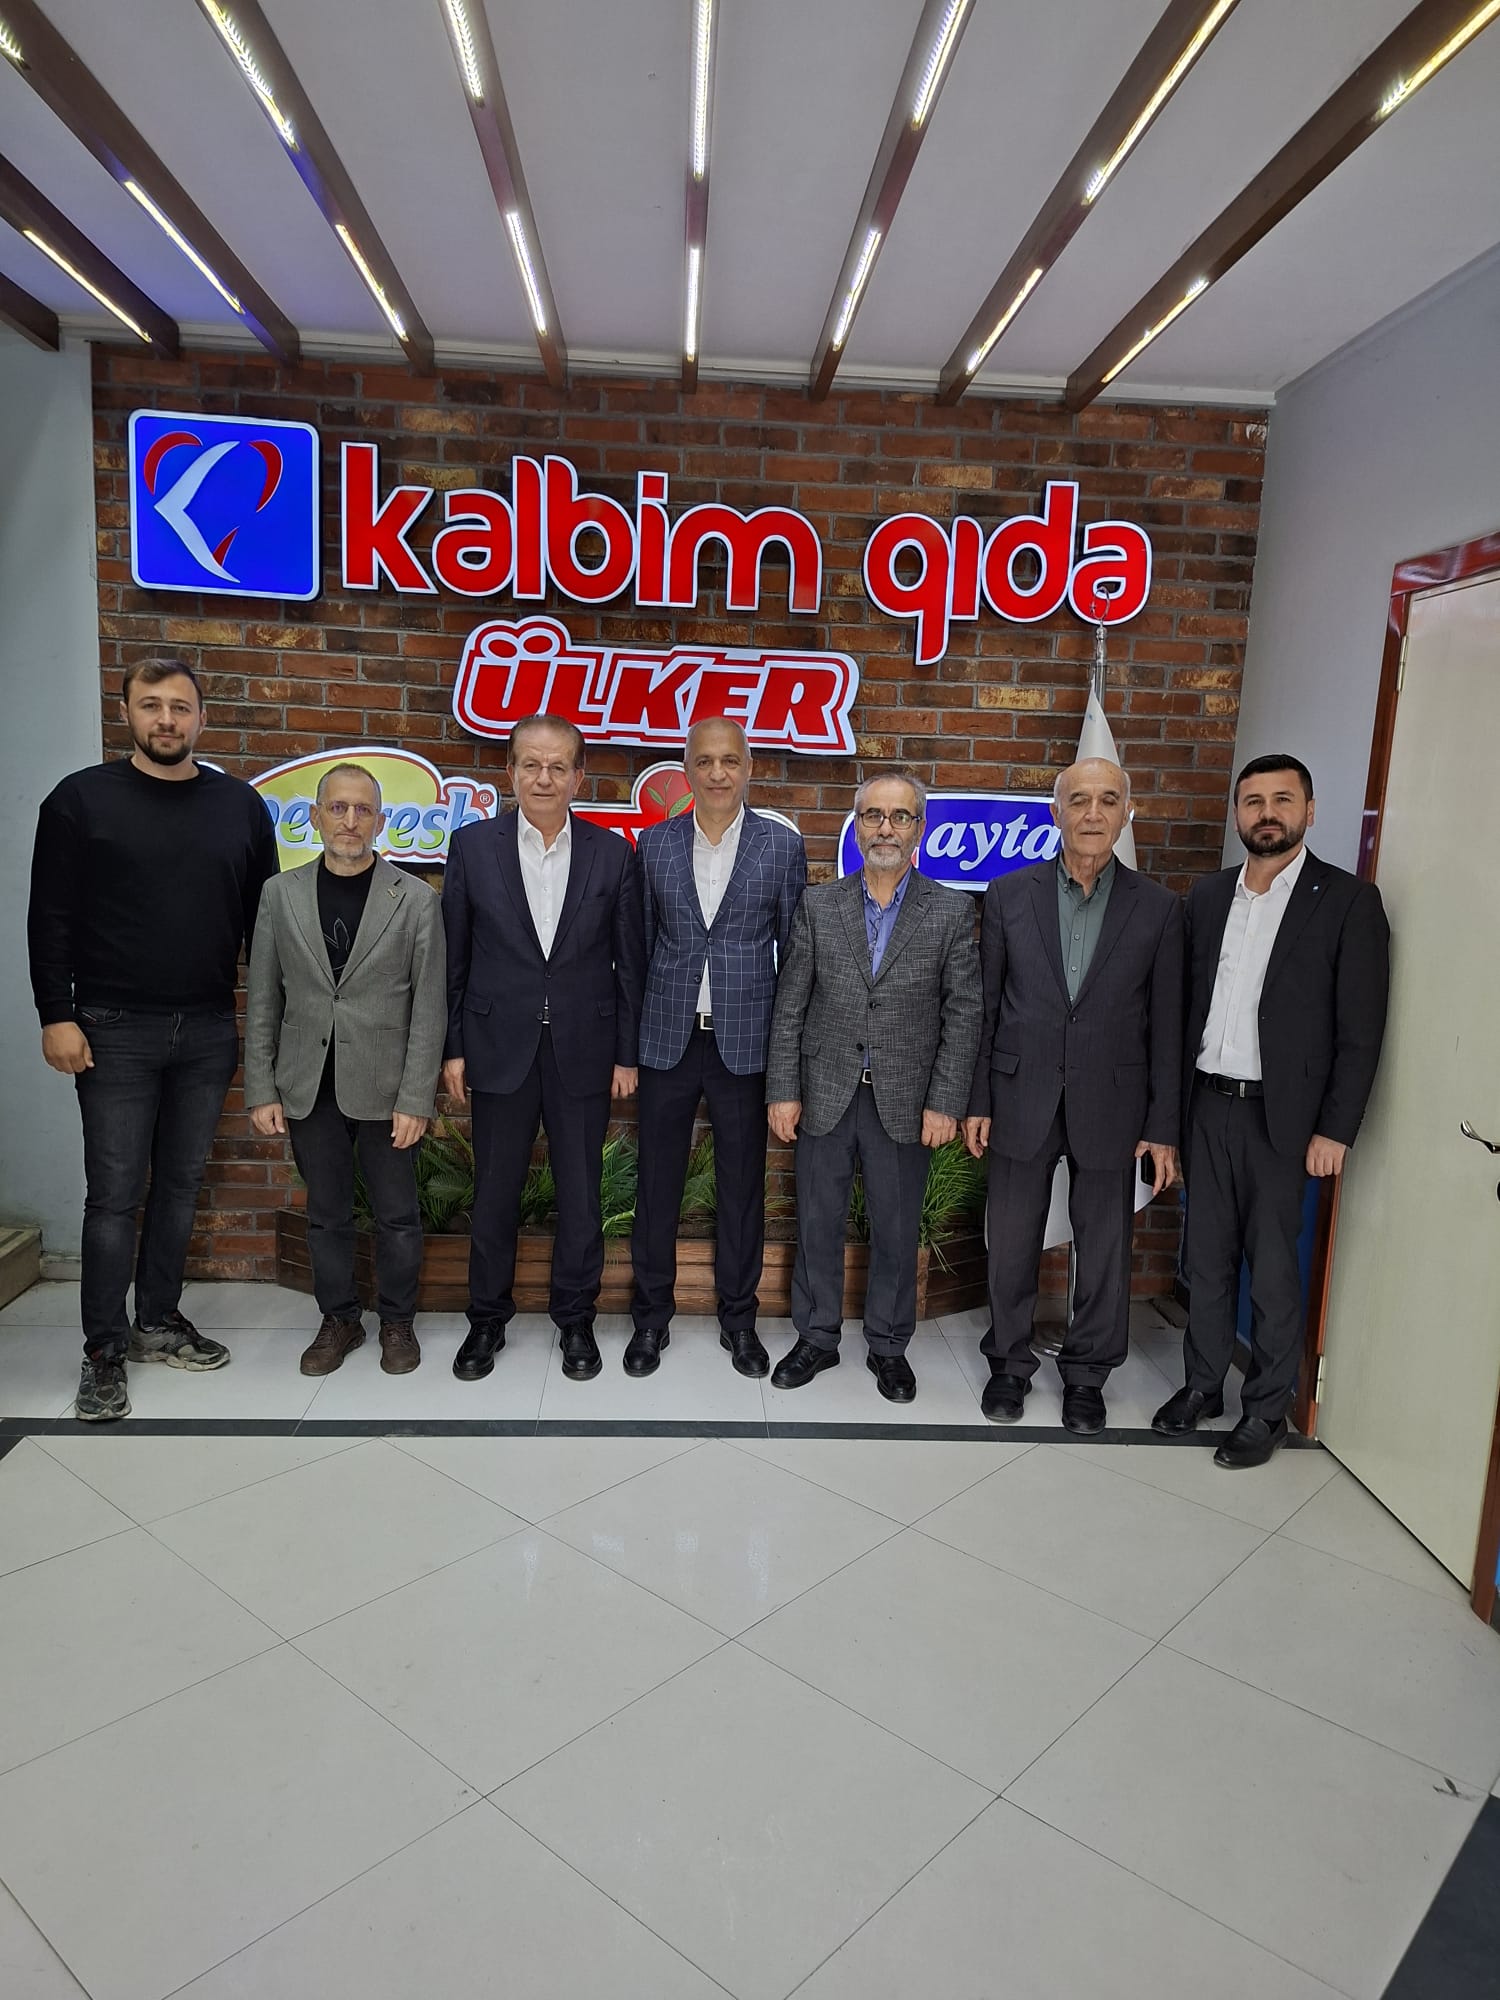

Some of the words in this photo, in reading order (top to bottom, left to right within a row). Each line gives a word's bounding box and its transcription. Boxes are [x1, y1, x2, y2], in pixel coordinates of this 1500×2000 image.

[340, 440, 823, 614] kalbim
[470, 634, 838, 738] ÜLKER
[925, 813, 1061, 871] ayta
